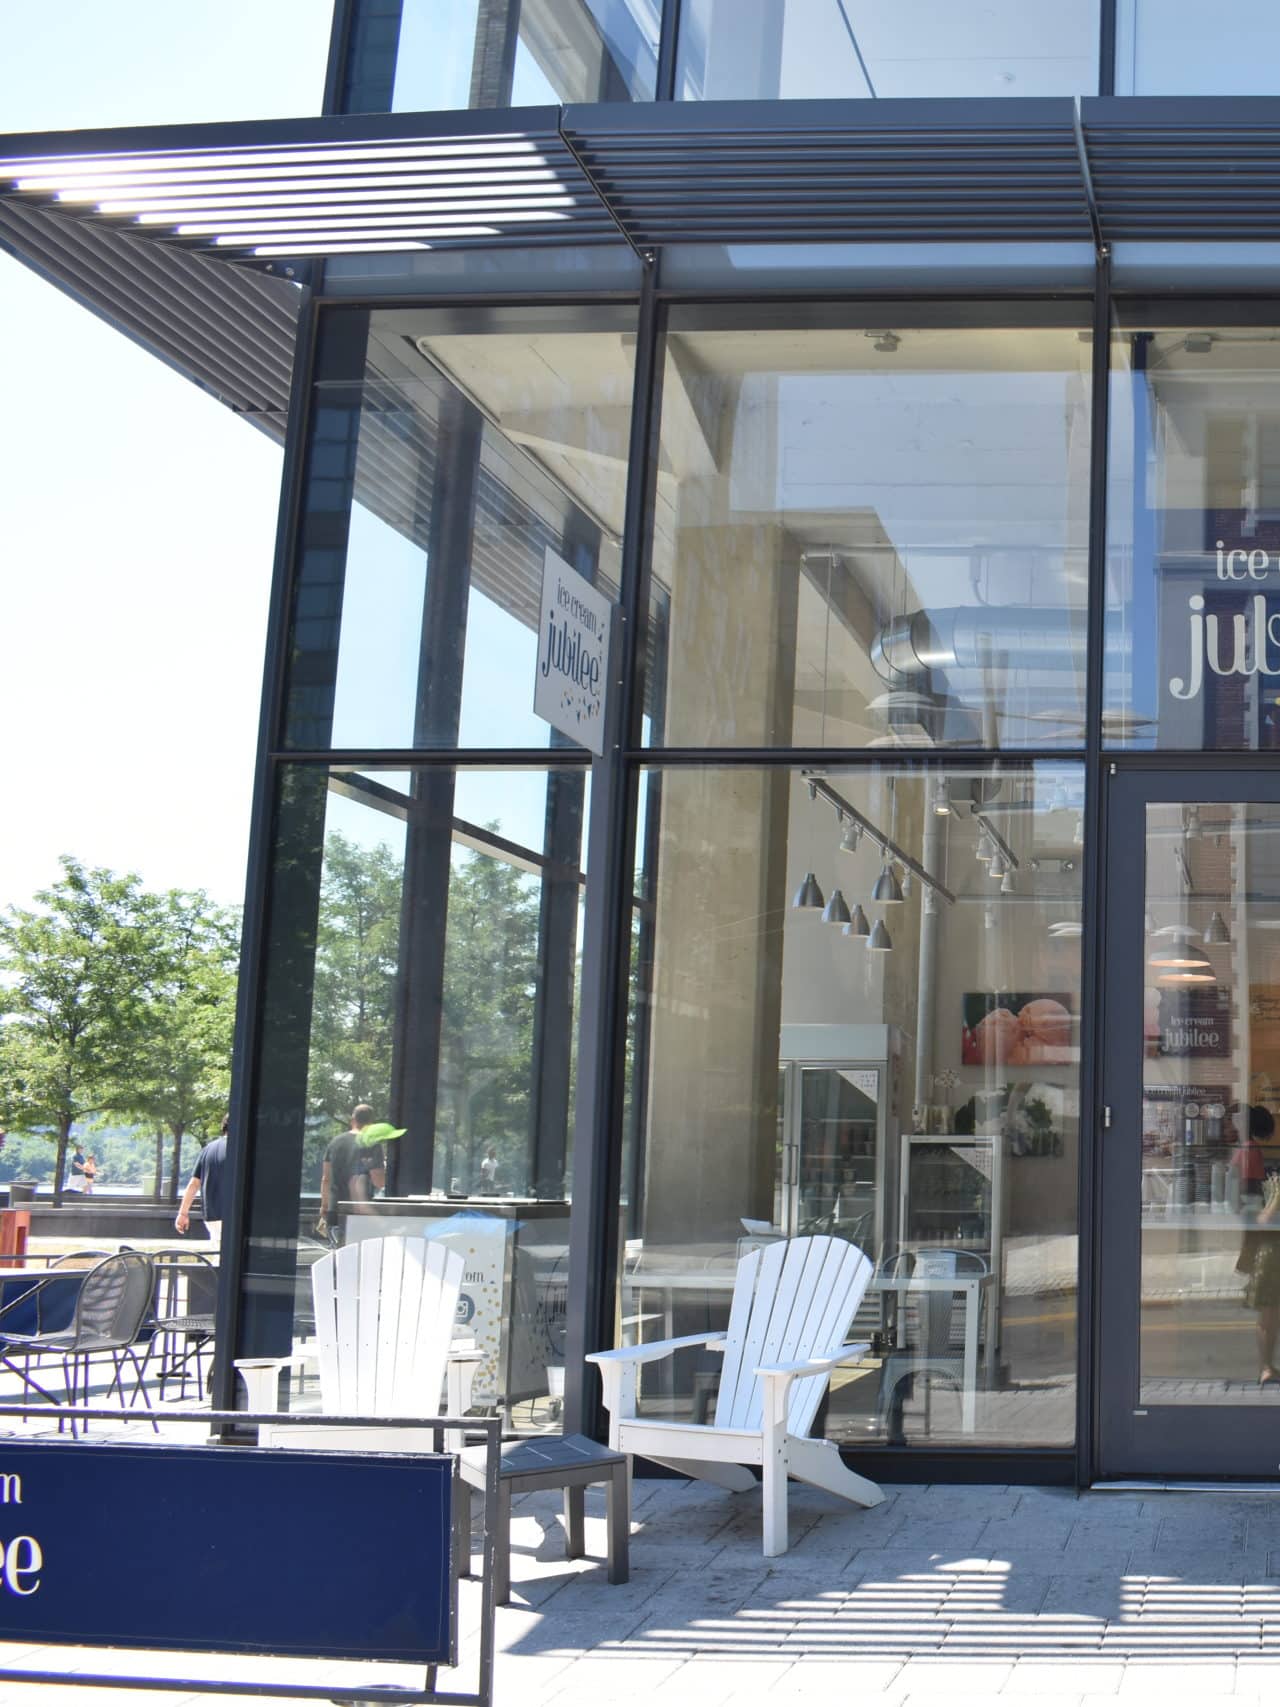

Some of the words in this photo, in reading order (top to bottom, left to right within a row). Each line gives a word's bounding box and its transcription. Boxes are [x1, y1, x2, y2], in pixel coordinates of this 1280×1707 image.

[1216, 540, 1269, 580] ice
[557, 577, 571, 611] ice
[571, 595, 597, 634] cream
[542, 610, 599, 697] jubilee
[1161, 1027, 1220, 1052] jubilee
